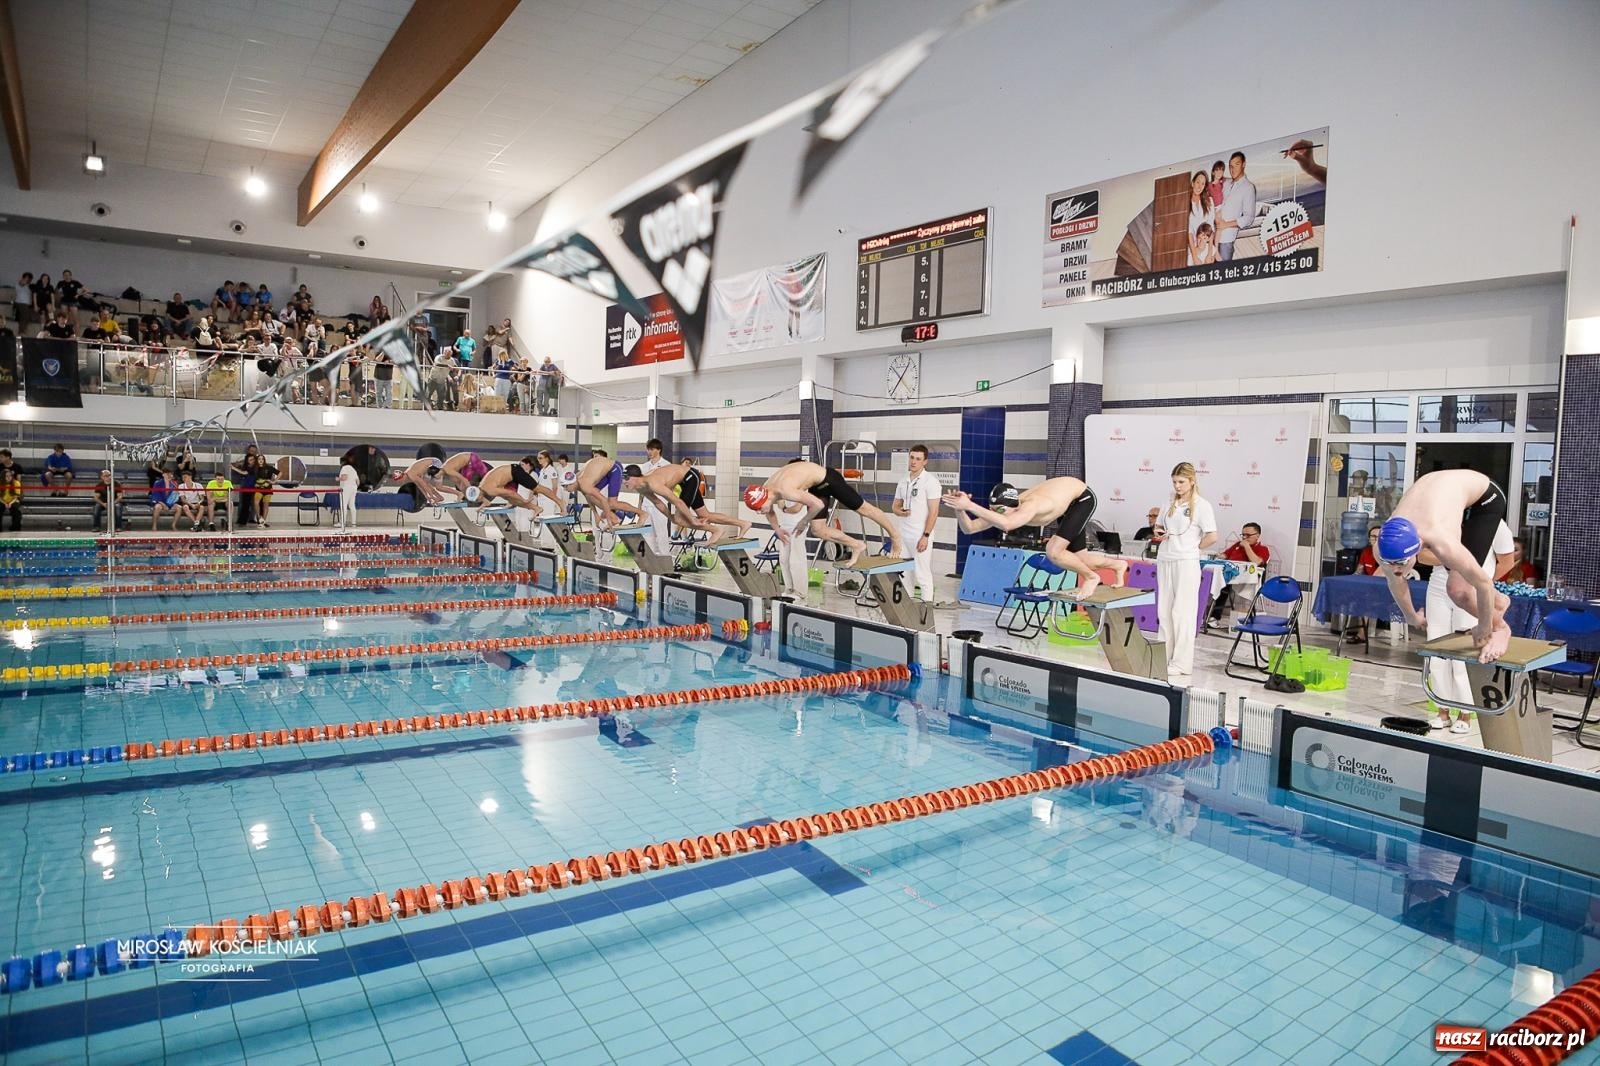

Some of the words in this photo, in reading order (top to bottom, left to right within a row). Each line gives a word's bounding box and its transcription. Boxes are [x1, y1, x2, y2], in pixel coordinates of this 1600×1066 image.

[1079, 219, 1097, 231] DRZWI
[1266, 207, 1304, 233] -15%
[1060, 239, 1088, 253] BRAMY
[1271, 230, 1310, 253] MONTAŻEM
[921, 256, 929, 266] 5.
[1063, 254, 1088, 268] DRZWI
[860, 270, 867, 278] 1.
[920, 273, 928, 283] 6.
[1059, 269, 1087, 284] PANELE
[1095, 277, 1143, 297] RACIBÓRZ
[1146, 278, 1158, 290] ul.
[1159, 272, 1207, 288] Głubczycka
[1208, 269, 1222, 281] 13,
[1225, 265, 1240, 279] tel:
[1242, 264, 1255, 277] 32
[1263, 260, 1282, 274] 415
[1284, 258, 1297, 271] 25
[1299, 256, 1313, 268] 00
[860, 285, 867, 295] 2.
[920, 290, 928, 299] 7.
[1065, 285, 1086, 299] OKNA
[860, 301, 867, 310] 3.
[919, 307, 927, 316] 8.
[859, 316, 866, 325] 4.
[625, 327, 637, 341] rtk
[505, 519, 512, 532] 2
[562, 528, 570, 543] 3
[637, 540, 646, 558] 4
[739, 556, 749, 577] 5
[892, 580, 903, 604] 6
[1124, 616, 1135, 648] 7
[1481, 684, 1506, 710] 8
[1518, 678, 1530, 718] 8
[1337, 755, 1388, 775] Colorado
[1338, 764, 1356, 775] TIME
